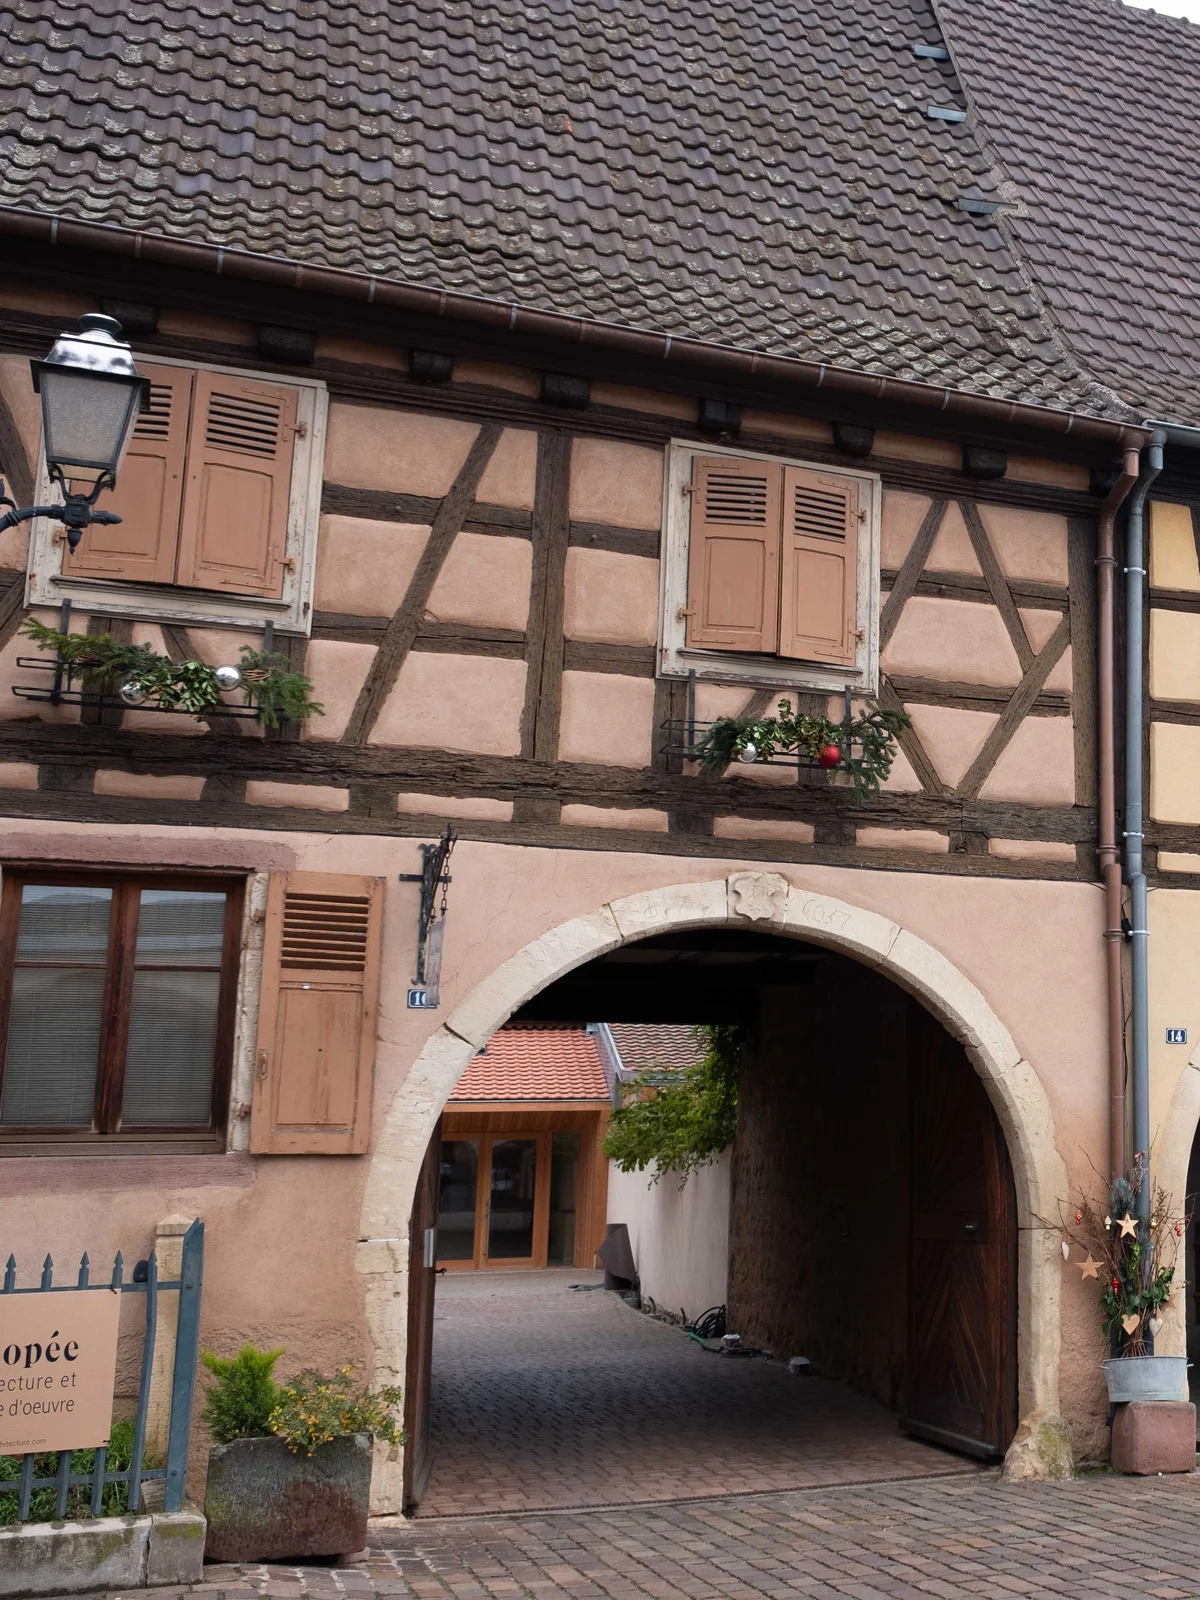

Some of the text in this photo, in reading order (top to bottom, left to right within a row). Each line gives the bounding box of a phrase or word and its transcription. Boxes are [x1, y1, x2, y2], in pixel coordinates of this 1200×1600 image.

[1171, 1030, 1182, 1042] 14
[3, 1330, 79, 1369] opée
[60, 1372, 76, 1388] et
[9, 1399, 75, 1417] d'oeuvre
